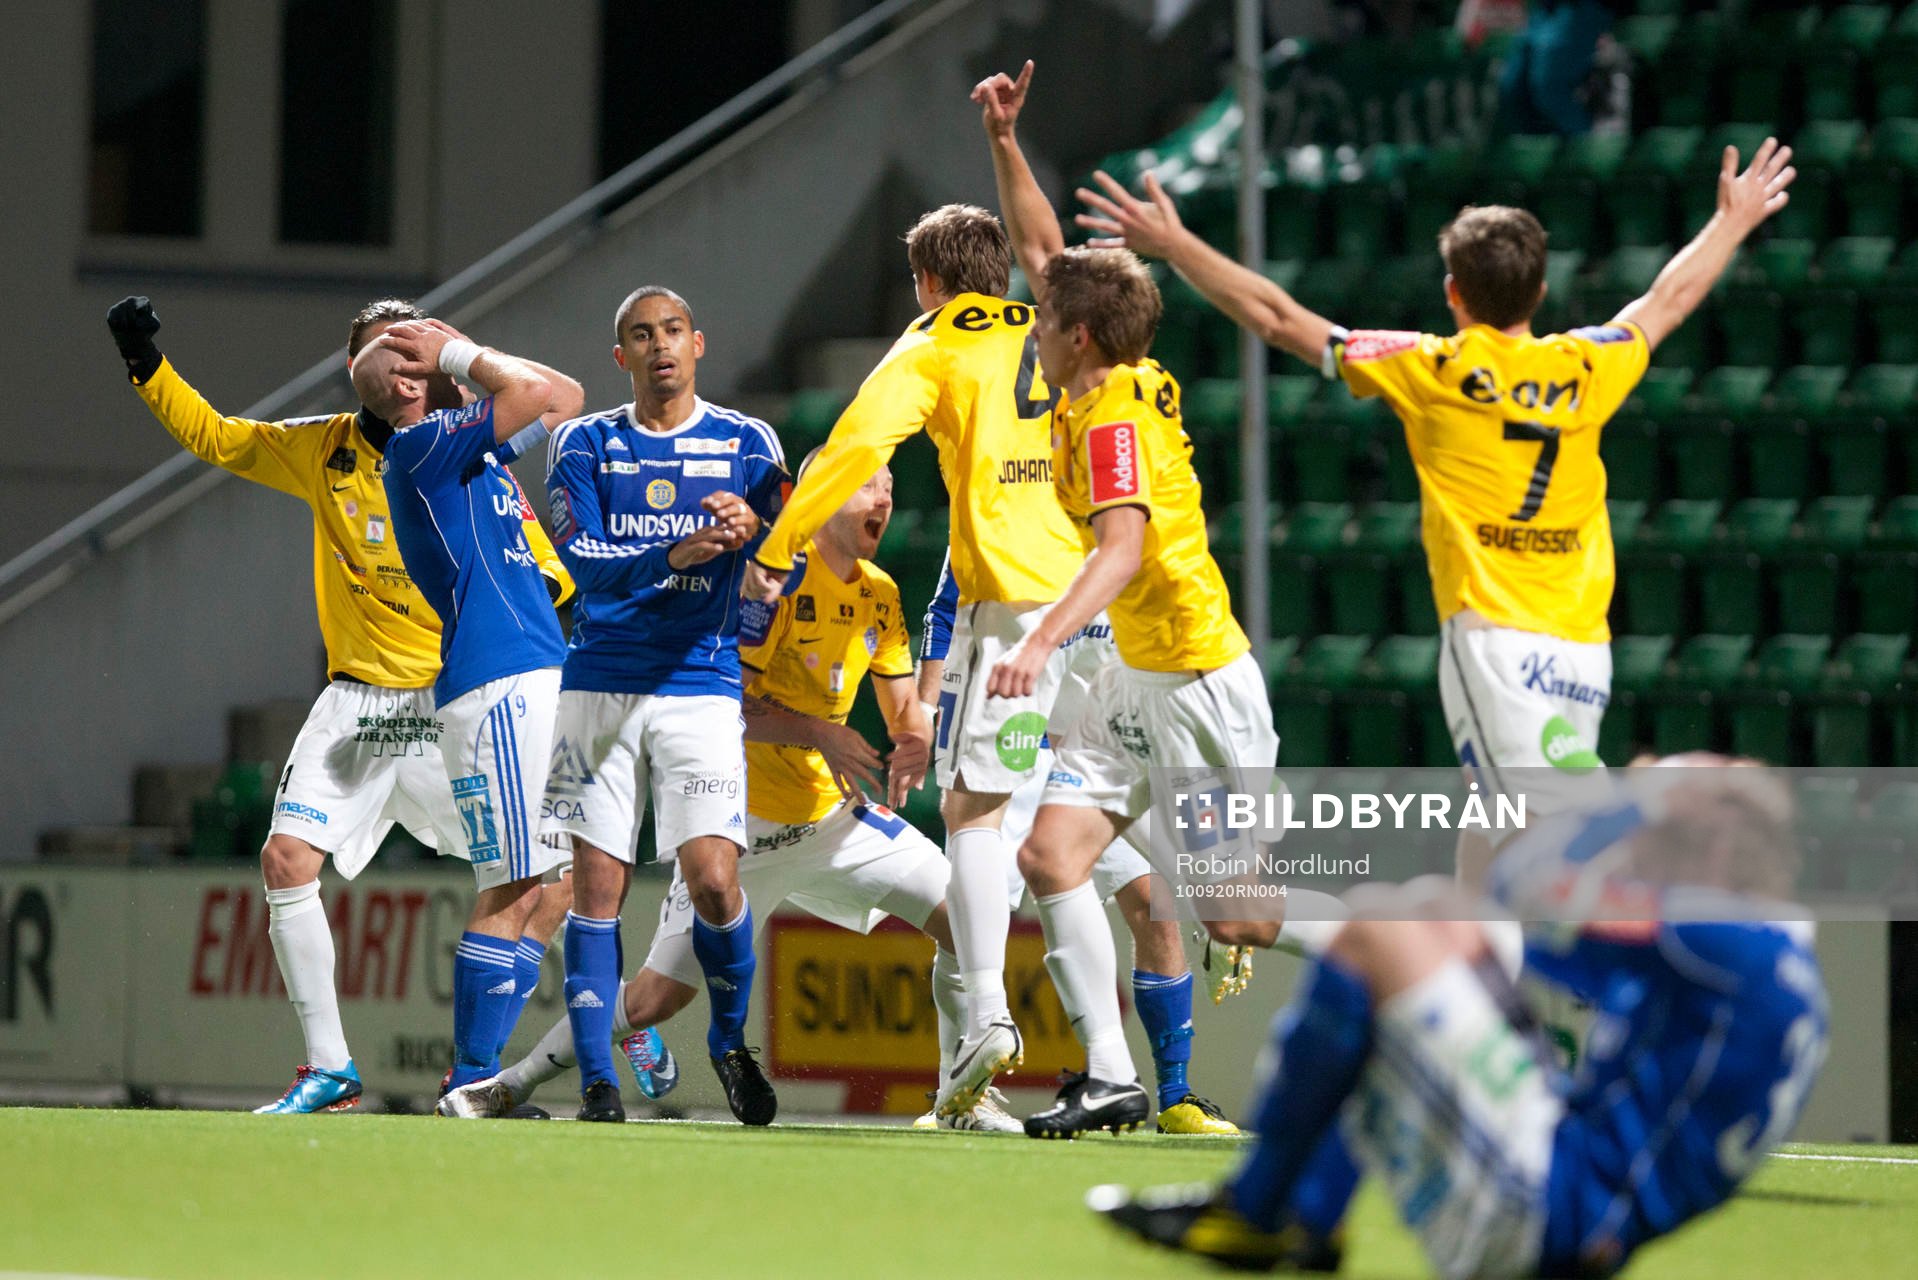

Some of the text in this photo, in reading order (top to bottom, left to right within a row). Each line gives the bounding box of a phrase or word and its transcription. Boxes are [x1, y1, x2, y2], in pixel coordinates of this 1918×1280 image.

[1114, 427, 1133, 492] Adecco
[1503, 420, 1561, 522] 7
[515, 695, 527, 718] 9
[541, 799, 587, 822] SCA
[190, 887, 425, 1001] EMART
